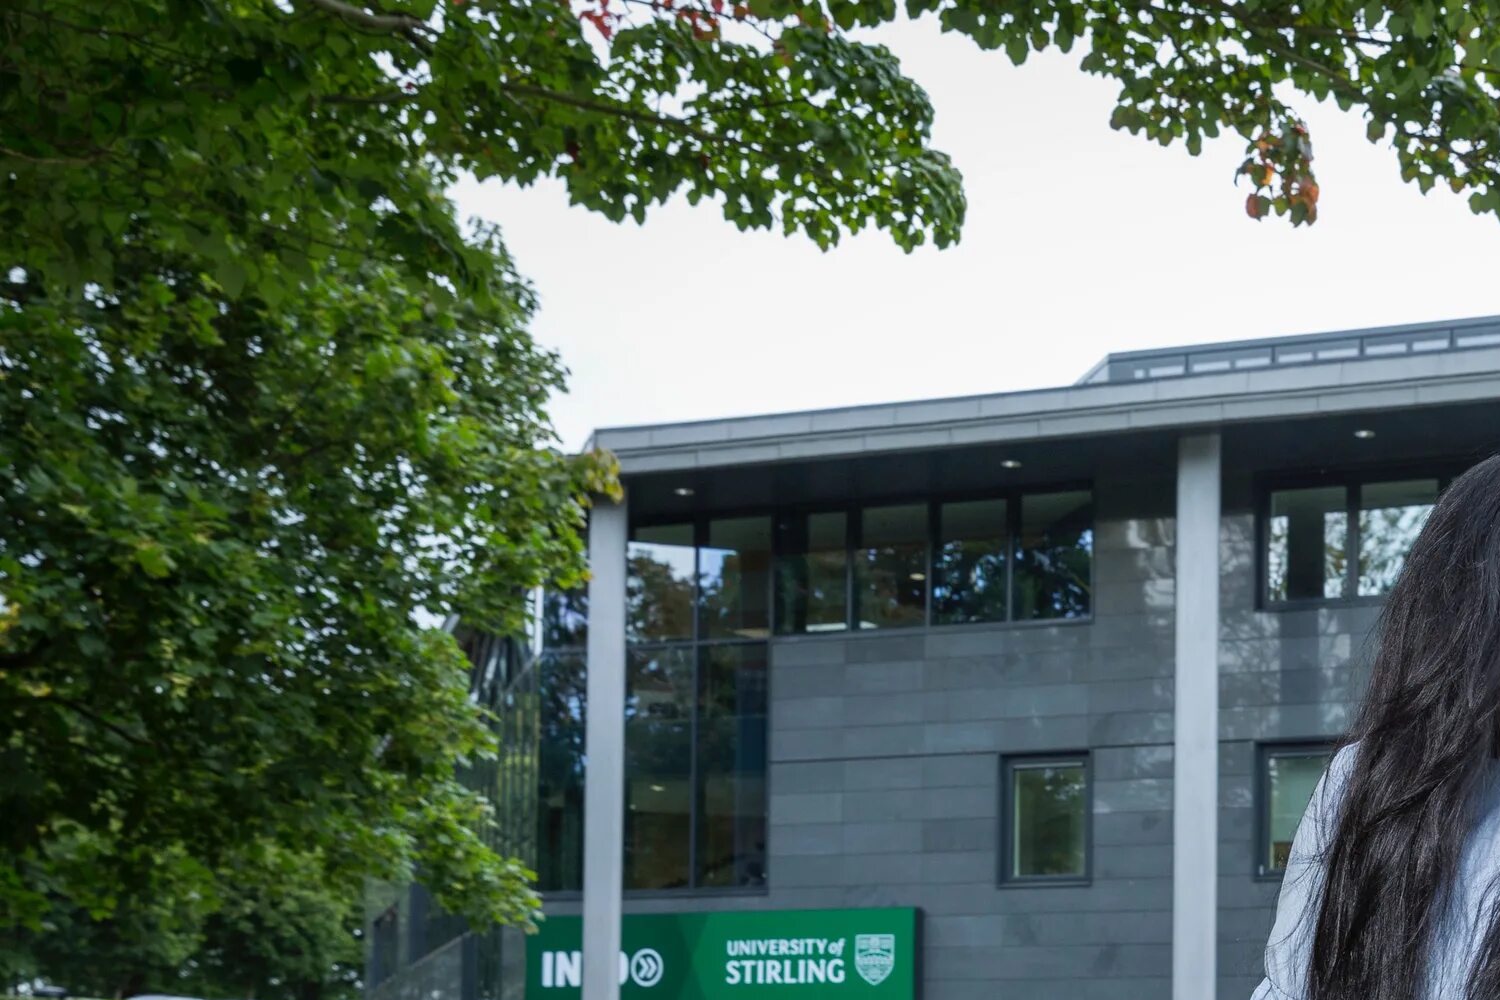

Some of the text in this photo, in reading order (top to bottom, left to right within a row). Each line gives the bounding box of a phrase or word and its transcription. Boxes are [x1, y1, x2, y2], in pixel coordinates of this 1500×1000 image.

[726, 938, 846, 957] UNIVERSITY of
[542, 951, 629, 987] IN
[726, 959, 845, 984] STIRLING
